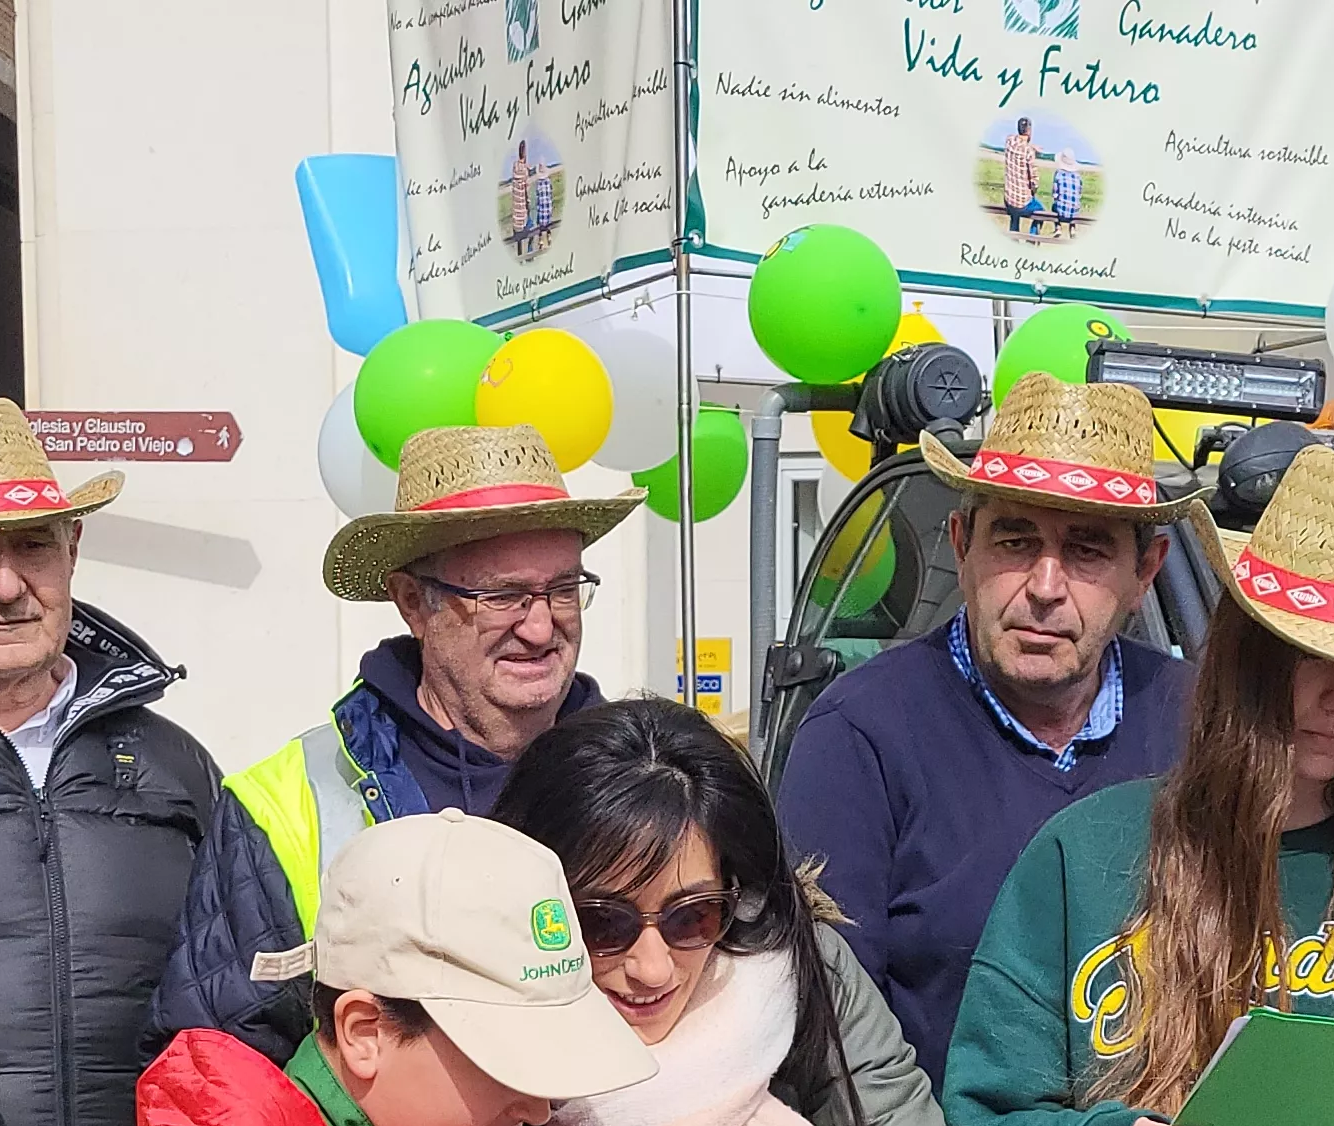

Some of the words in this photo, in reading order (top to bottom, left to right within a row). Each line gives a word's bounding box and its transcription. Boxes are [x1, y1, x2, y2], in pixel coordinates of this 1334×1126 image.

[1118, 0, 1258, 50] Ganadero
[903, 17, 983, 82] Vida
[997, 64, 1024, 108] y
[1039, 44, 1161, 104] Futuro
[460, 85, 500, 141] Vida
[525, 57, 591, 116] Futuro
[716, 72, 772, 99] Nadie
[778, 82, 811, 103] sin
[816, 86, 902, 119] alimentos
[725, 155, 782, 187] Apoyo
[787, 159, 800, 174] a
[808, 147, 829, 172] la
[1165, 129, 1253, 160] Agricultura
[1257, 144, 1329, 167] sostenible
[632, 186, 672, 214] social
[859, 180, 935, 206] extensiva
[1227, 202, 1300, 232] intensiva
[1165, 217, 1188, 242] No
[1191, 230, 1202, 244] a
[1206, 225, 1223, 248] la
[1227, 234, 1261, 258] peste
[1267, 242, 1313, 265] social
[960, 242, 1009, 270] Relevo
[1013, 257, 1118, 281] generacional
[44, 436, 73, 452] San
[75, 436, 120, 452] Pedro
[122, 436, 136, 452] el
[137, 436, 175, 456] Viejo
[72, 421, 82, 437] y
[84, 418, 146, 434] Claustro
[519, 962, 562, 982] JOHN
